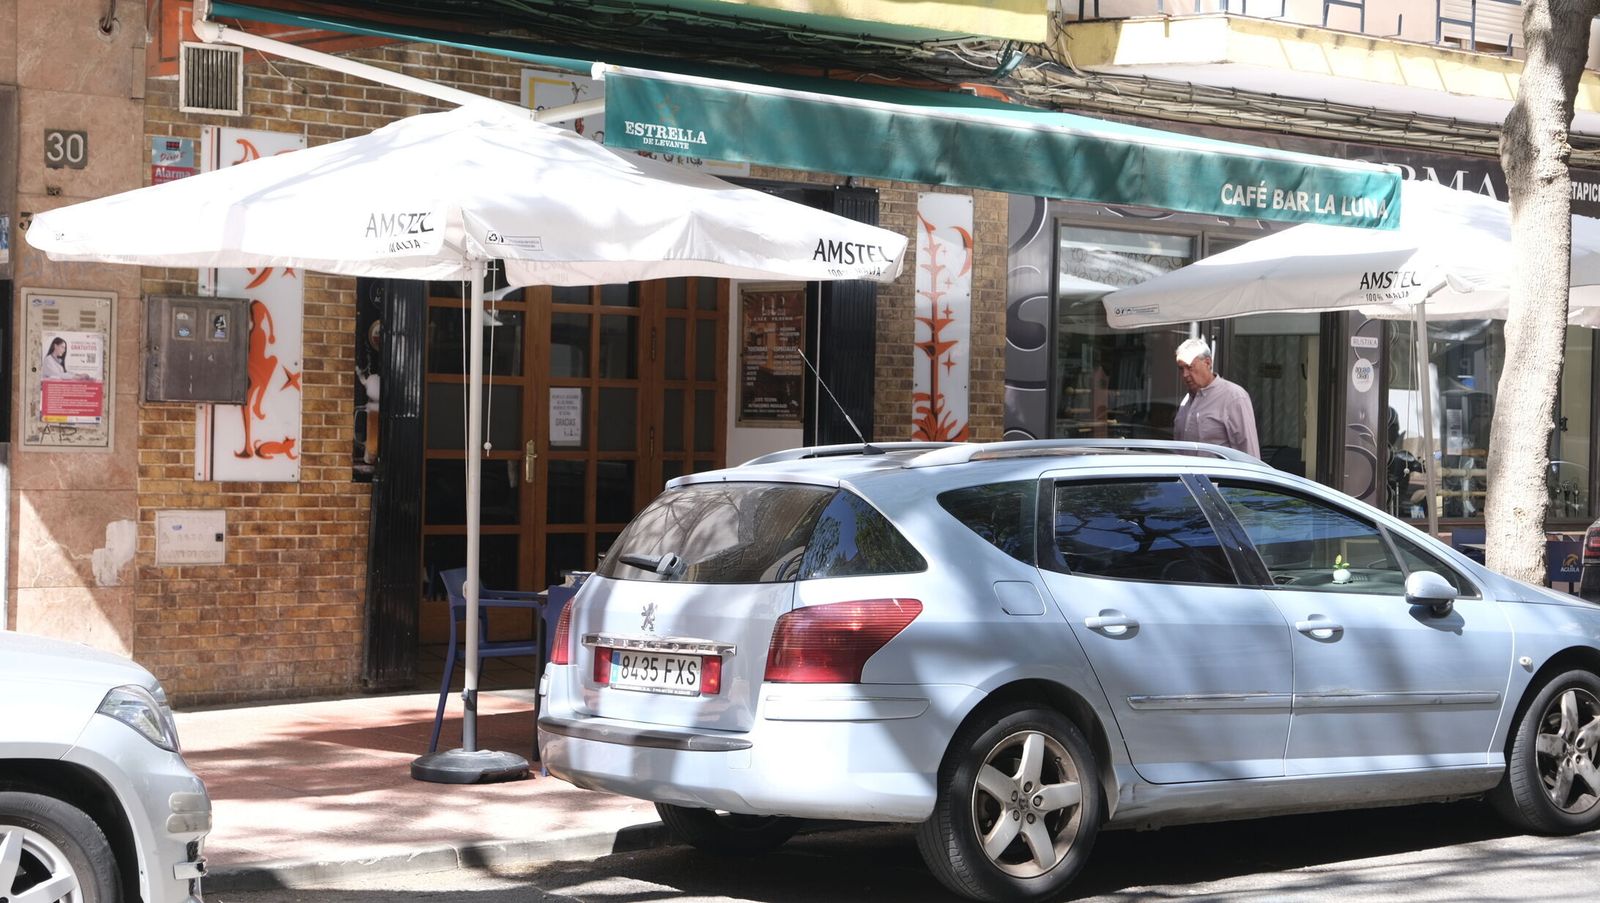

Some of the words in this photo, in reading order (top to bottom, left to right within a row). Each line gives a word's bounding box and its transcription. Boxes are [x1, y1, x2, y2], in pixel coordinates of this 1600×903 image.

[624, 120, 707, 145] ESTRELLA
[642, 137, 655, 146] DE
[655, 138, 689, 150] LEVANTE
[46, 133, 84, 162] 30
[155, 167, 192, 179] Alarma
[1220, 180, 1267, 208] CAFÉ
[1272, 188, 1310, 212] BAR
[1314, 192, 1336, 215] LA
[1341, 196, 1389, 219] LUNA
[1571, 181, 1600, 202] TAPIC
[813, 238, 894, 265] AMSTEL
[1359, 270, 1422, 290] AMSTEL
[1365, 292, 1384, 302] 100%
[1385, 291, 1409, 299] MALTA
[621, 655, 659, 682] 8435
[663, 658, 697, 685] FXS
